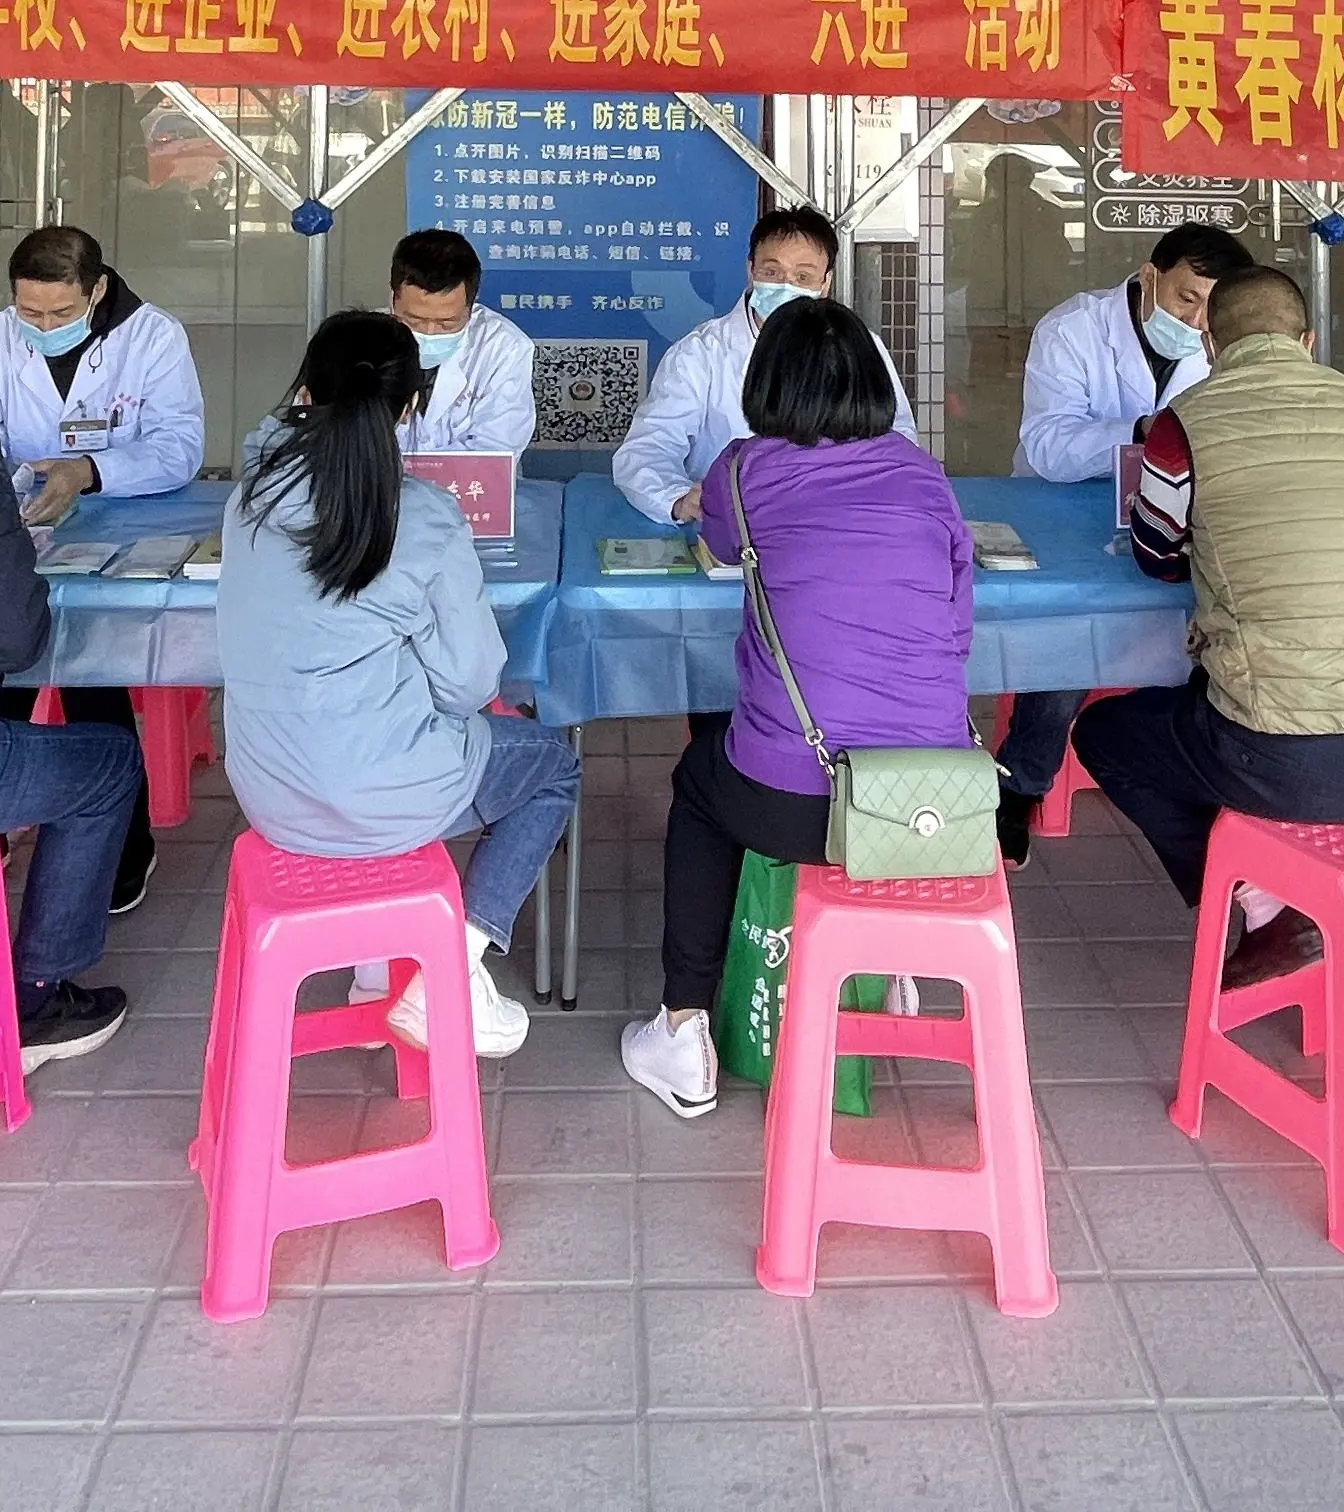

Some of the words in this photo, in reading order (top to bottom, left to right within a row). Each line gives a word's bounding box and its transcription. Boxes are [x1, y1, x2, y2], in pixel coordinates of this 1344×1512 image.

[428, 100, 745, 133] 防新冠一样，防范电信骗！
[856, 164, 882, 179] 119
[1137, 203, 1235, 227] 除湿驱寒
